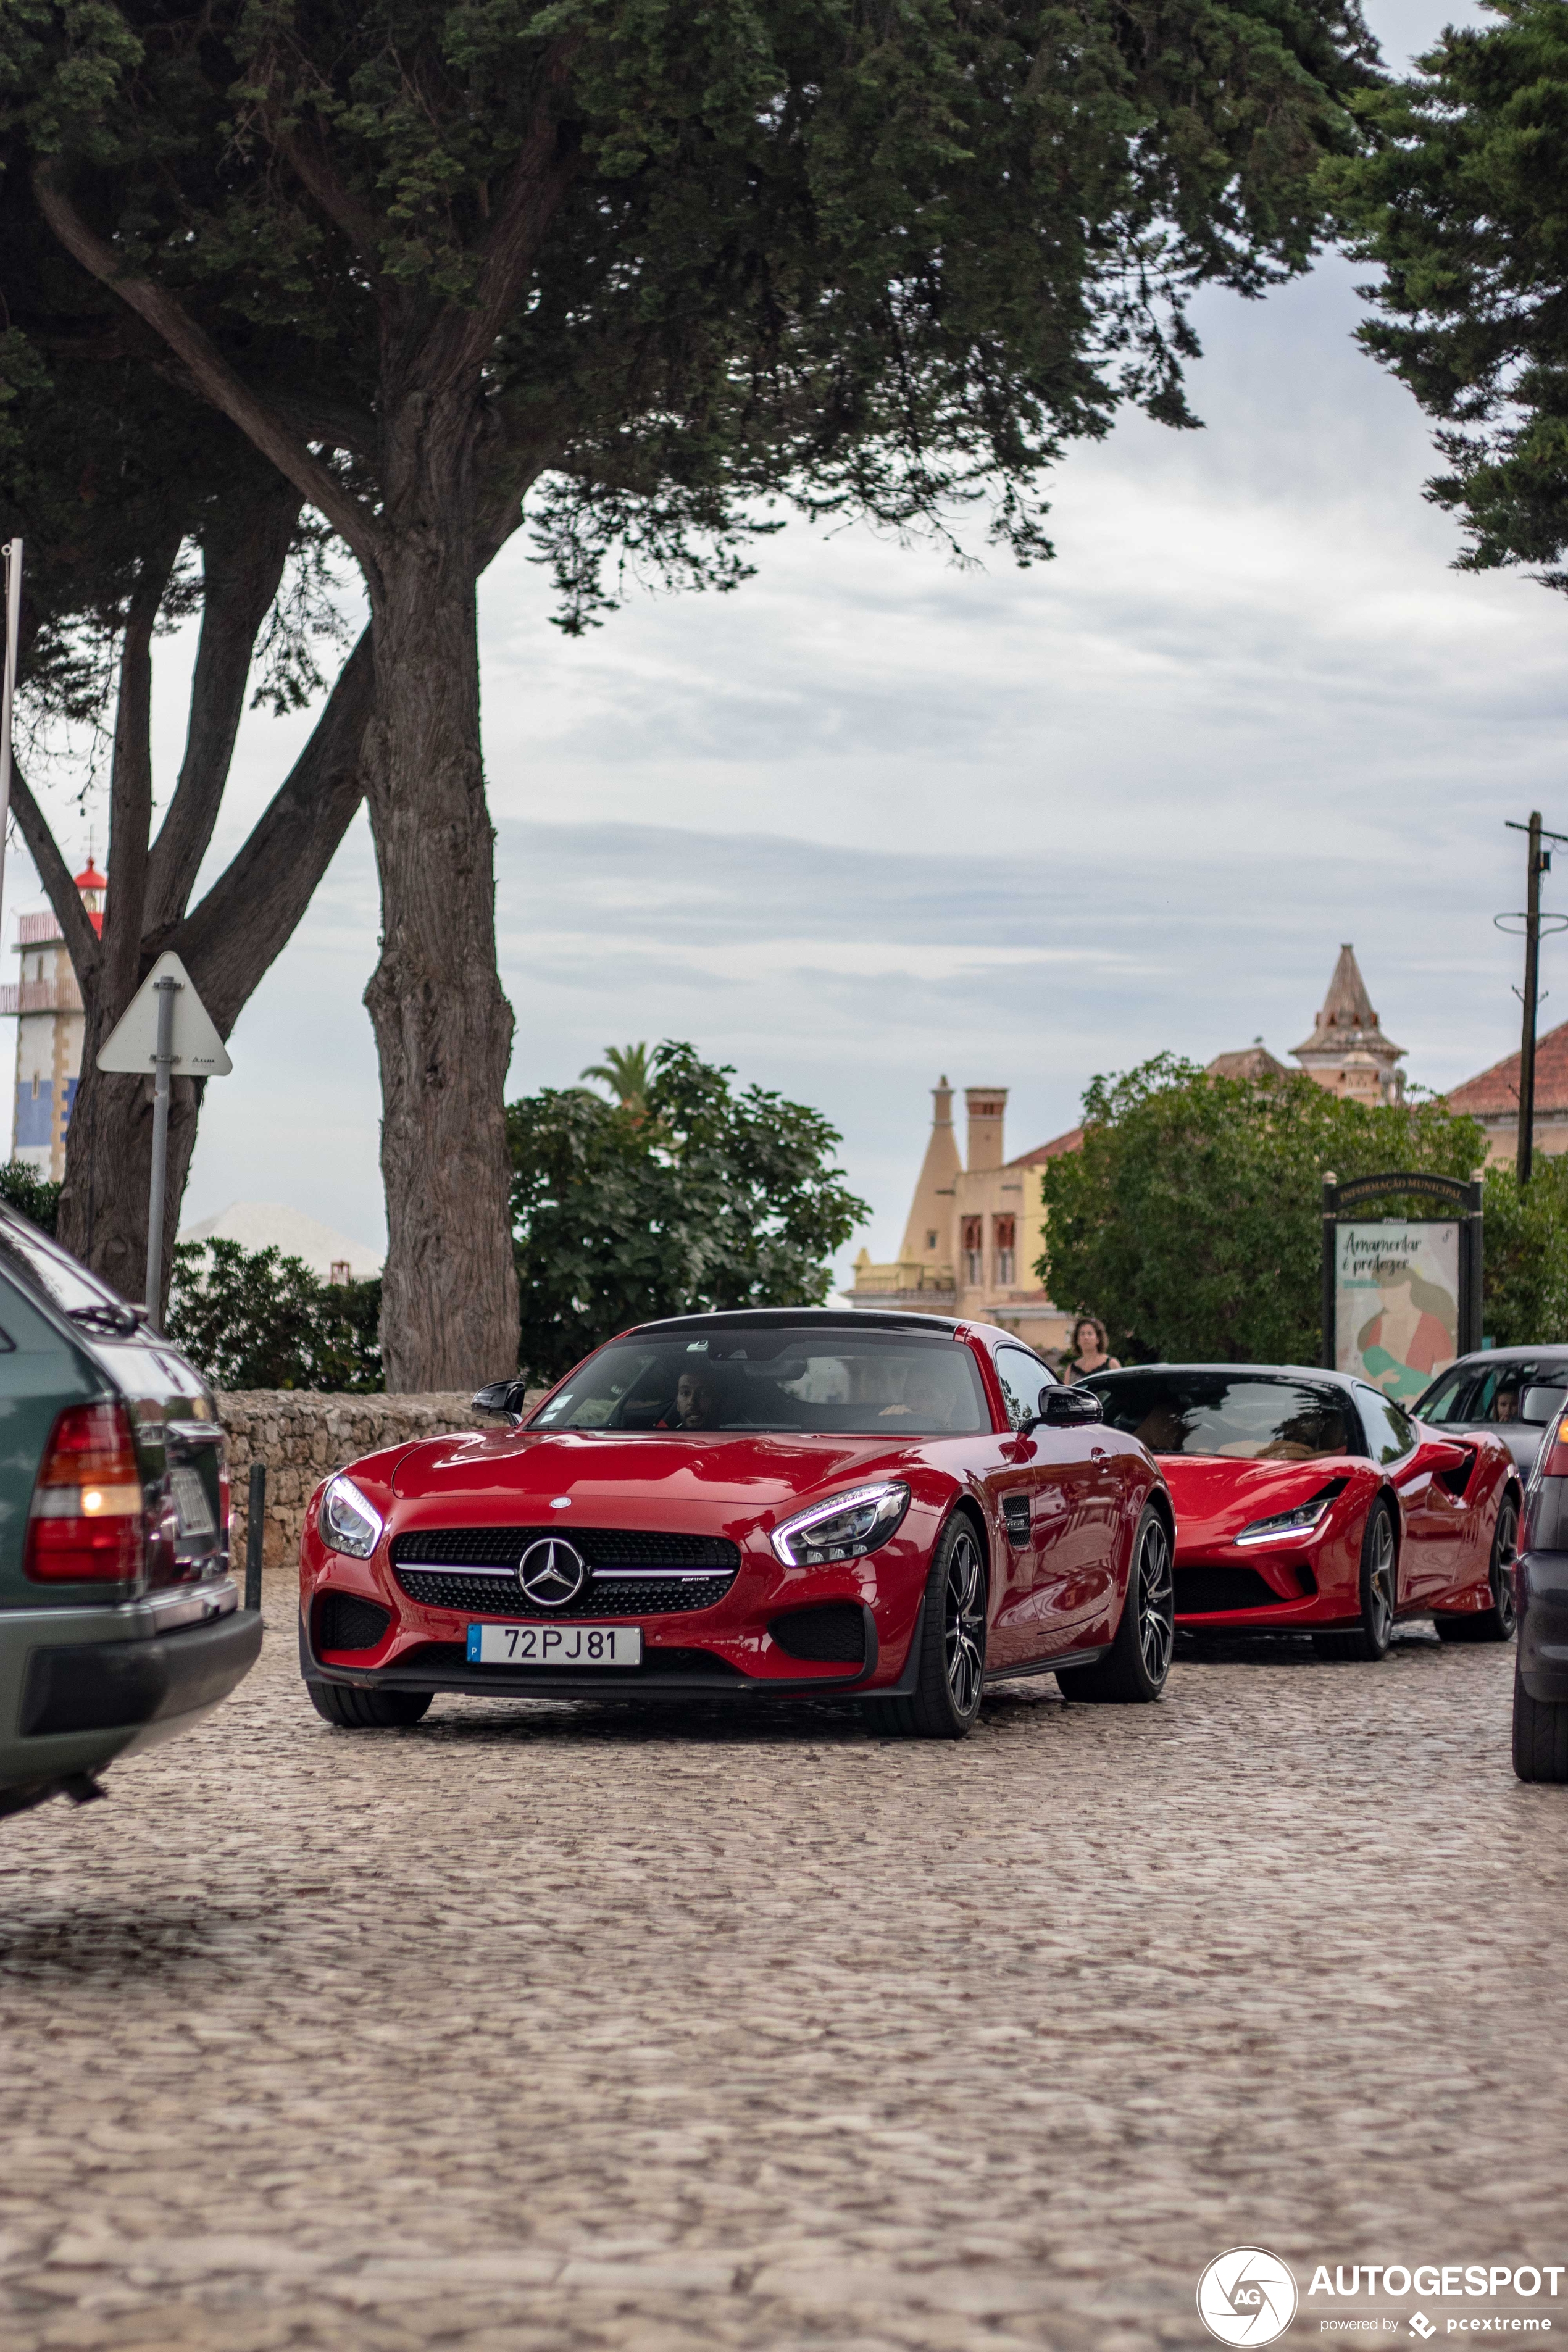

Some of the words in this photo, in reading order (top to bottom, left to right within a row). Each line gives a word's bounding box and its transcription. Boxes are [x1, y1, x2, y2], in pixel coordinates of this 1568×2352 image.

[1407, 1178, 1462, 1199] MUNICIPAL
[1345, 1230, 1422, 1256] Amamentar
[1353, 1254, 1410, 1277] proteger
[472, 1647, 477, 1656] P
